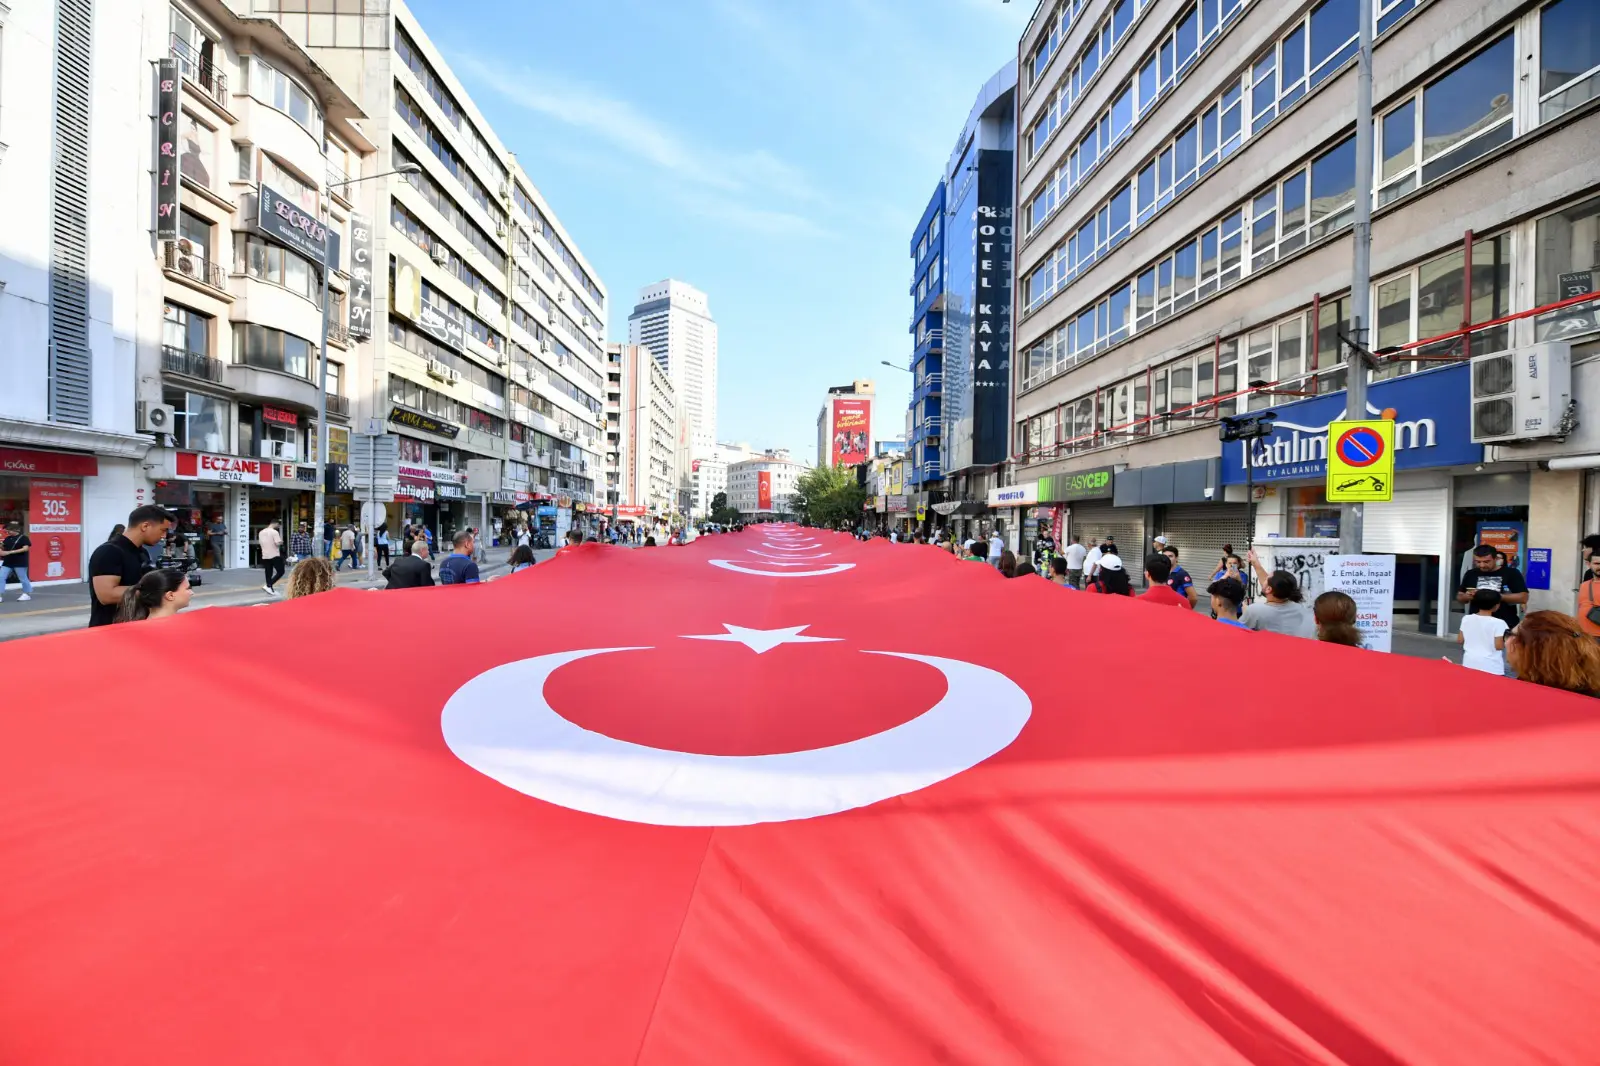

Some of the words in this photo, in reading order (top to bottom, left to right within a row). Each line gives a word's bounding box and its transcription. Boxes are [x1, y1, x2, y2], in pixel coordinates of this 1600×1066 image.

[979, 224, 996, 288] OTEL
[201, 455, 260, 474] ECZANE
[284, 465, 292, 477] E
[1267, 469, 1277, 477] EV
[1281, 464, 1320, 475] ALMANIN
[219, 471, 243, 481] BEYAZ
[1065, 471, 1109, 490] EASYCEP
[1367, 569, 1392, 578] İnşaat
